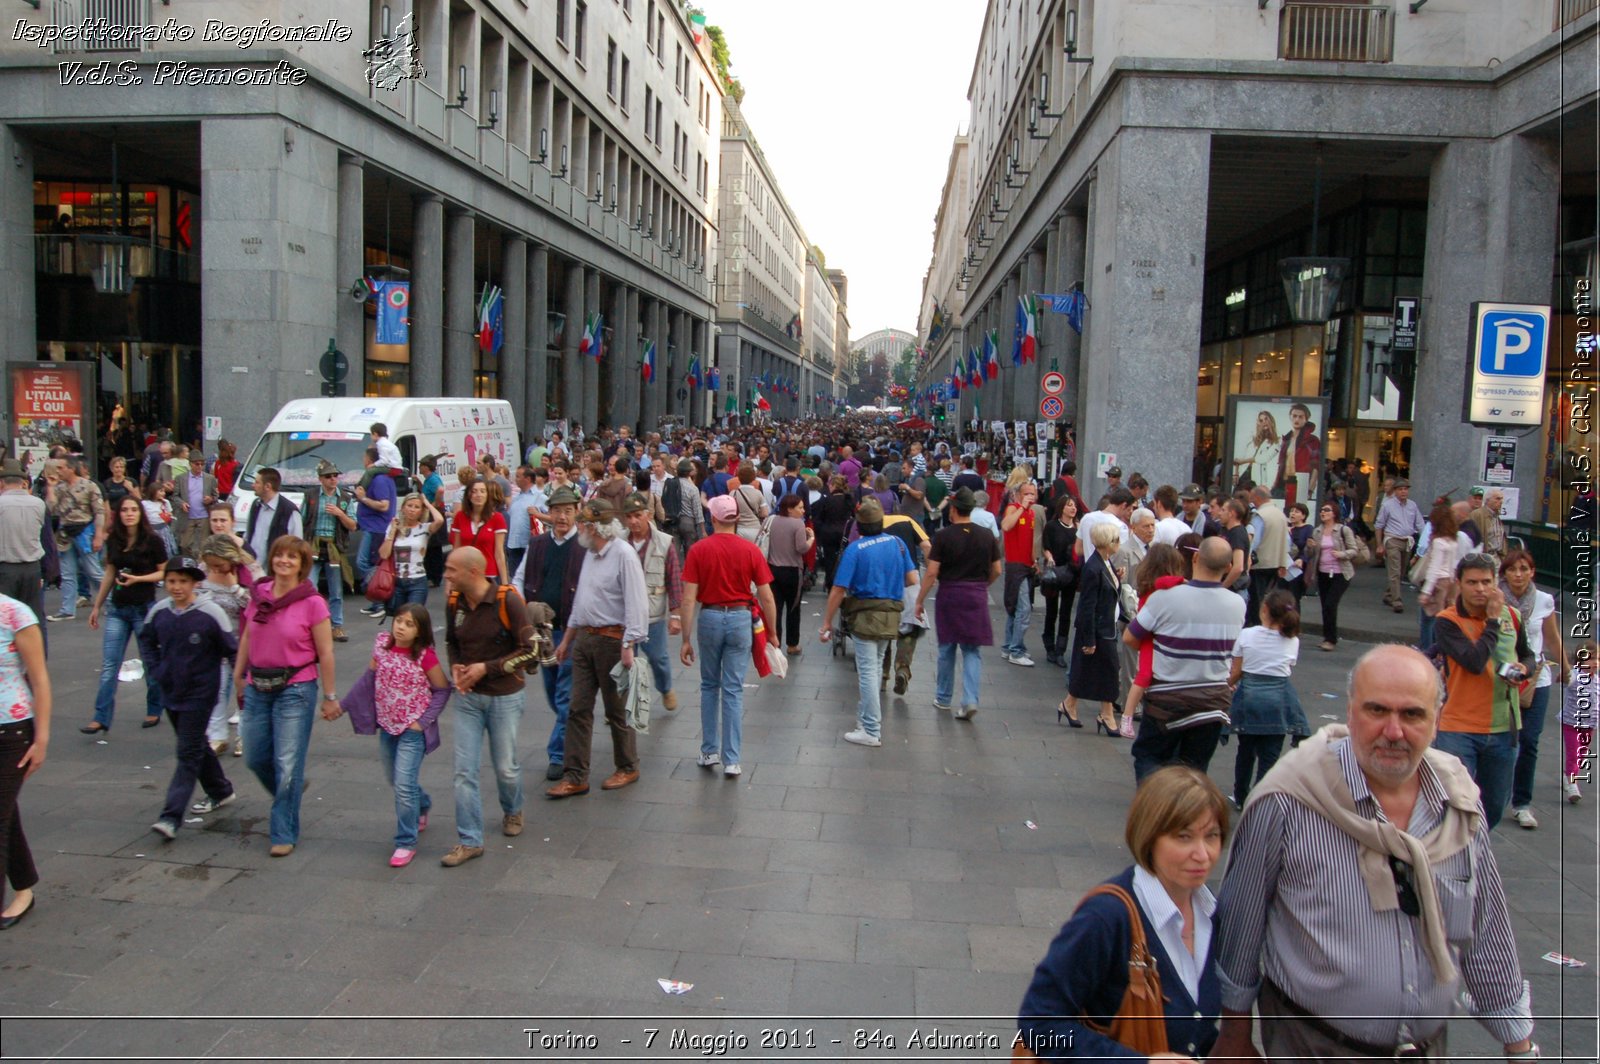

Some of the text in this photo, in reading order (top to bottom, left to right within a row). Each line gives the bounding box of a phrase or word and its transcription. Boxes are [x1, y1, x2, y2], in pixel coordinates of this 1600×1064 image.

[1398, 300, 1415, 327] T
[1494, 325, 1532, 371] P
[25, 390, 72, 401] L'ITALIA
[1477, 387, 1540, 397] Ingresso Pedonale
[33, 400, 65, 413] È QUI
